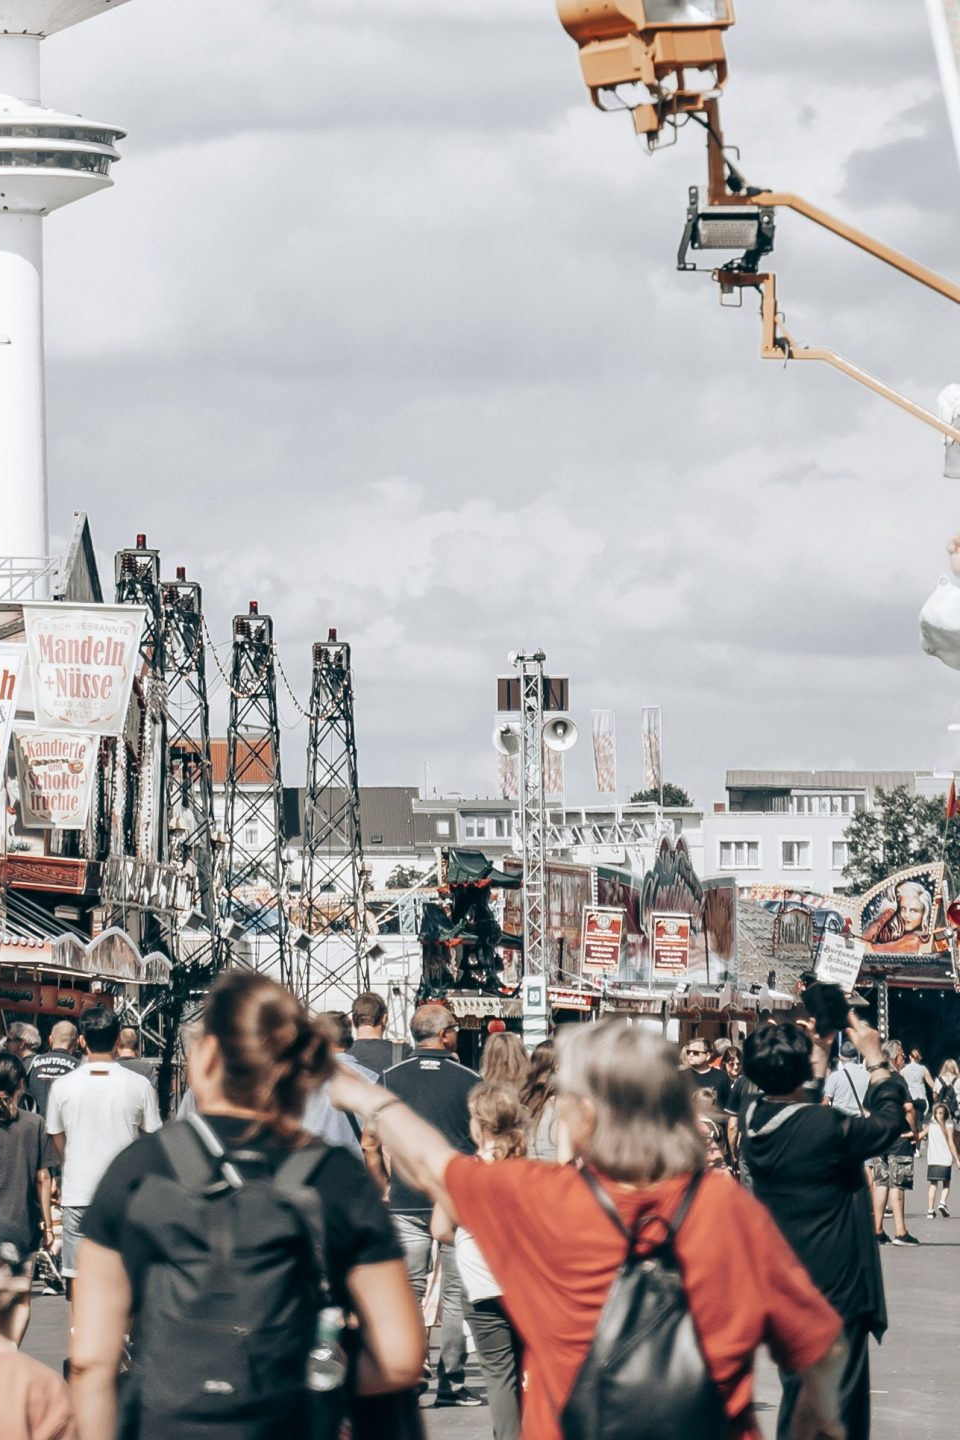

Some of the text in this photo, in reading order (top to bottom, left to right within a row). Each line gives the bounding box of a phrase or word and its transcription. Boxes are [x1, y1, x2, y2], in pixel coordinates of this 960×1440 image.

[38, 634, 125, 666] Mandeln
[26, 738, 86, 759] Kandierte
[30, 791, 79, 811] früchte
[33, 1057, 76, 1069] NAUTICAL
